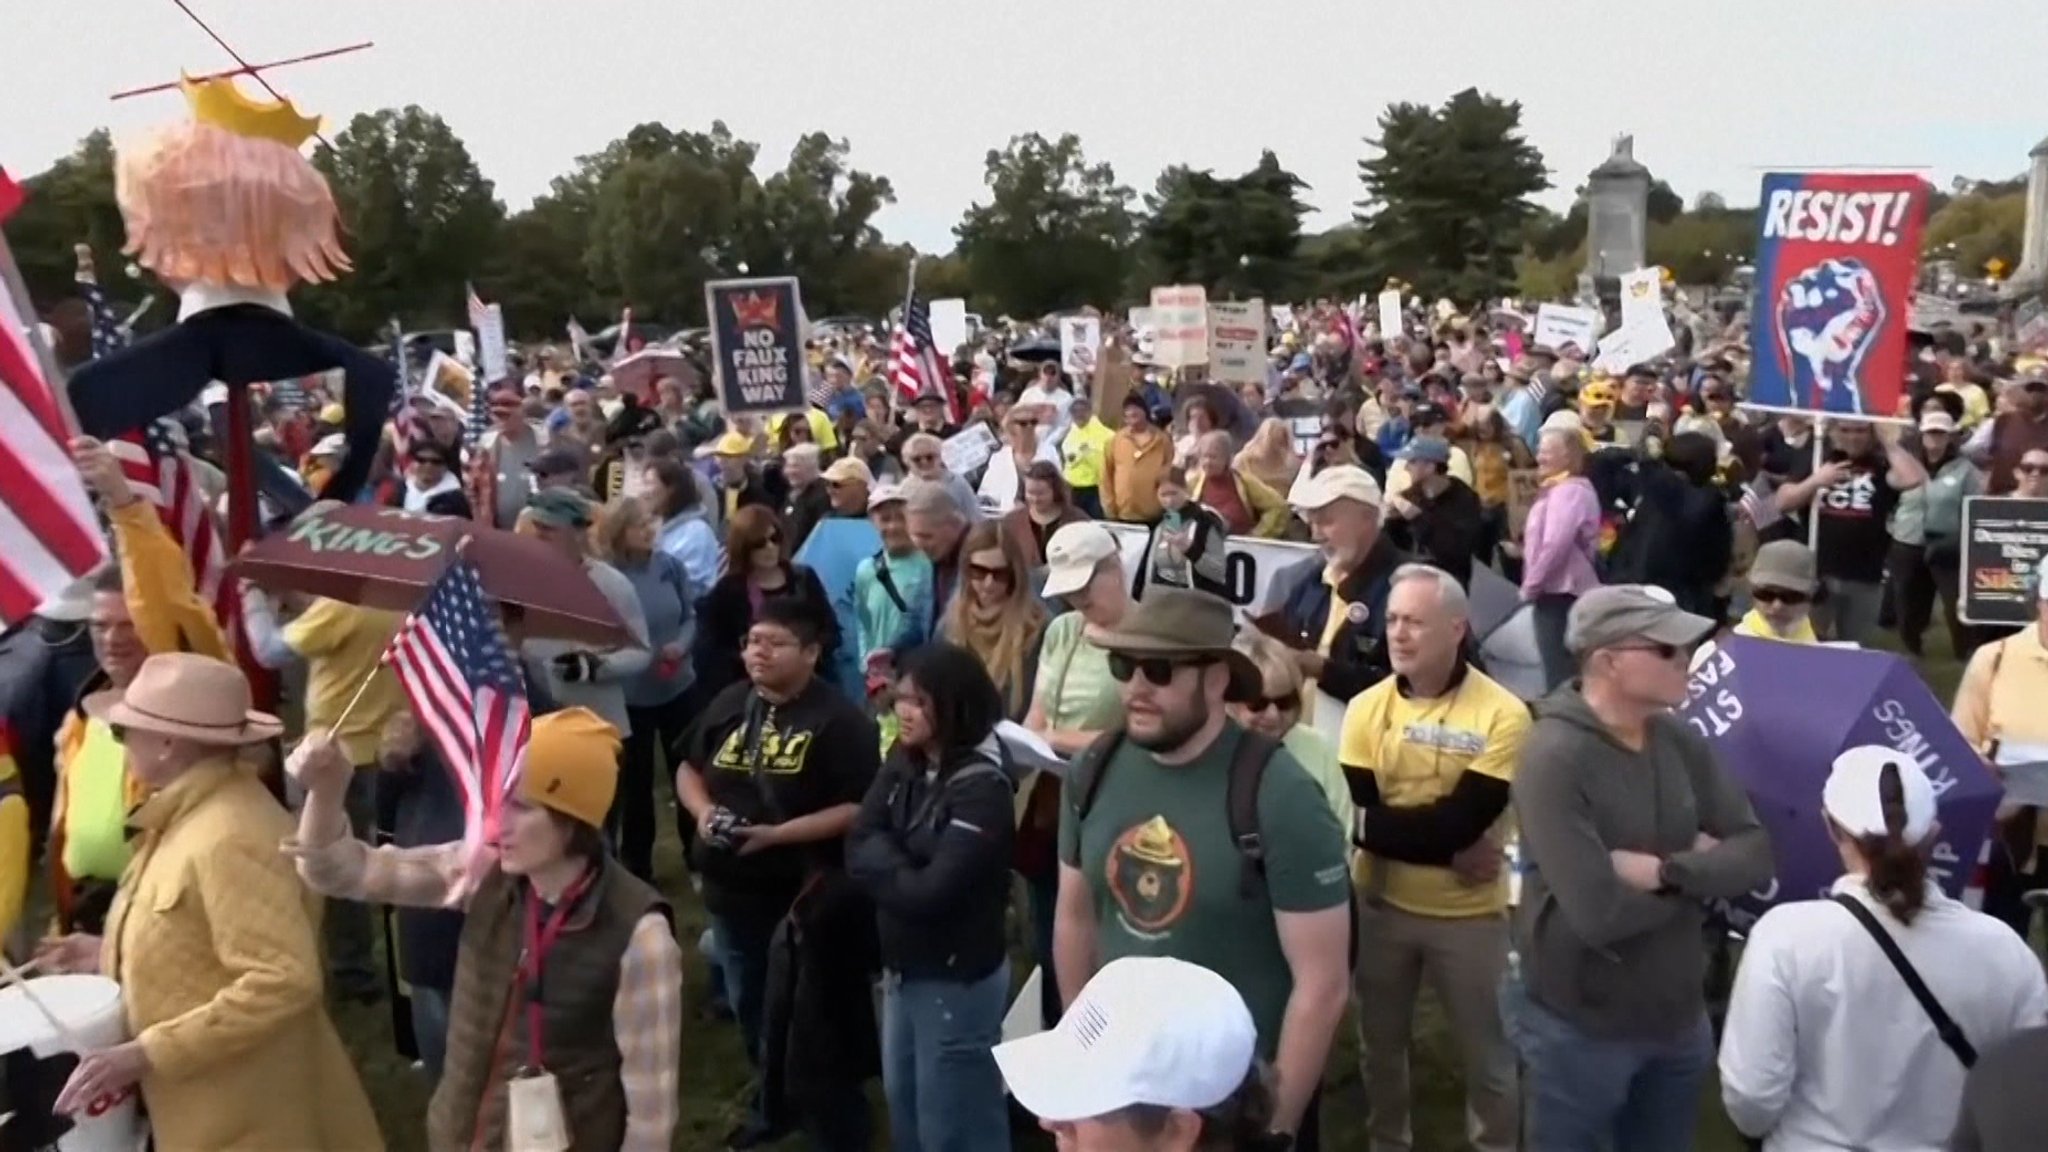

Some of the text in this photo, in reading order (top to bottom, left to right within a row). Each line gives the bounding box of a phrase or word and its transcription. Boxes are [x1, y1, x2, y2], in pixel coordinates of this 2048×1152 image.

[1763, 189, 1910, 246] RESIST!
[743, 328, 775, 348] NO
[732, 347, 787, 367] FAUX
[736, 365, 788, 385] KING
[741, 383, 786, 403] WAY
[286, 516, 441, 560] KINGS
